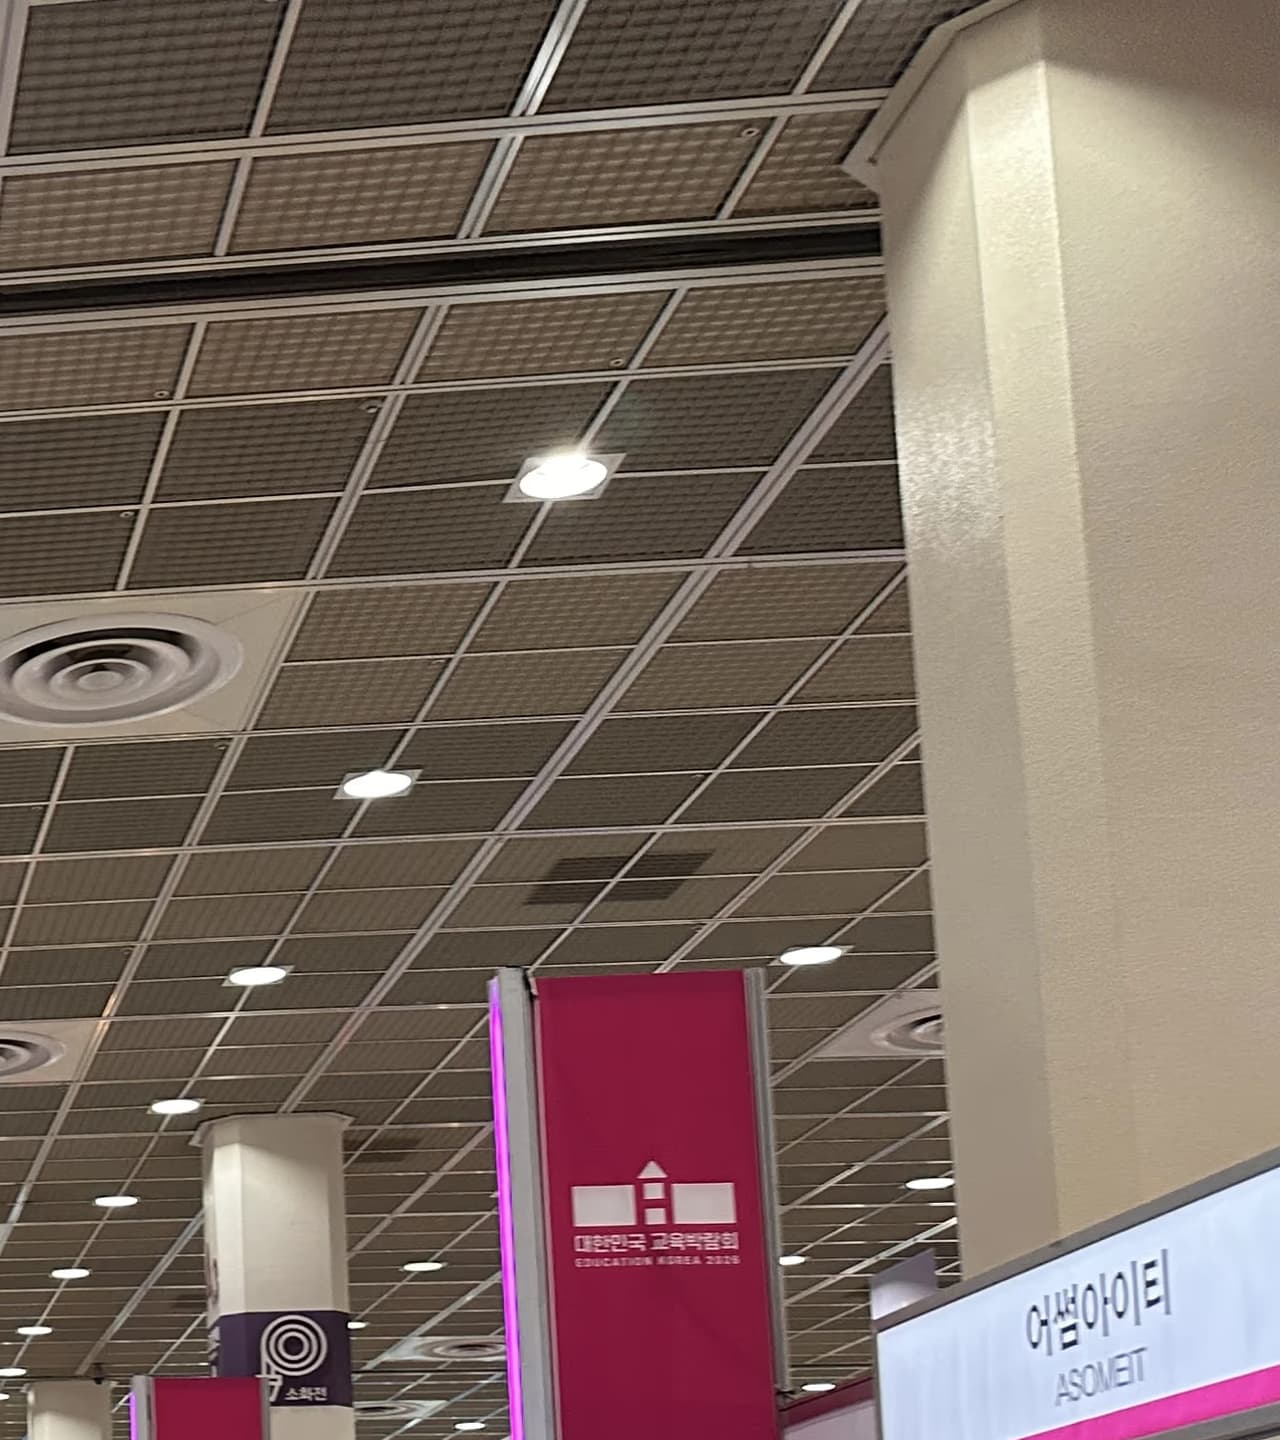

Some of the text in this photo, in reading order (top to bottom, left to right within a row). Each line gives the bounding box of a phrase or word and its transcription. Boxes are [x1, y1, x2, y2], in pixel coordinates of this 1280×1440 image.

[574, 1232, 738, 1252] 대한민국 교육박람회
[1026, 1249, 1171, 1356] 어썸아이티
[1056, 1347, 1147, 1406] ASOMEIT
